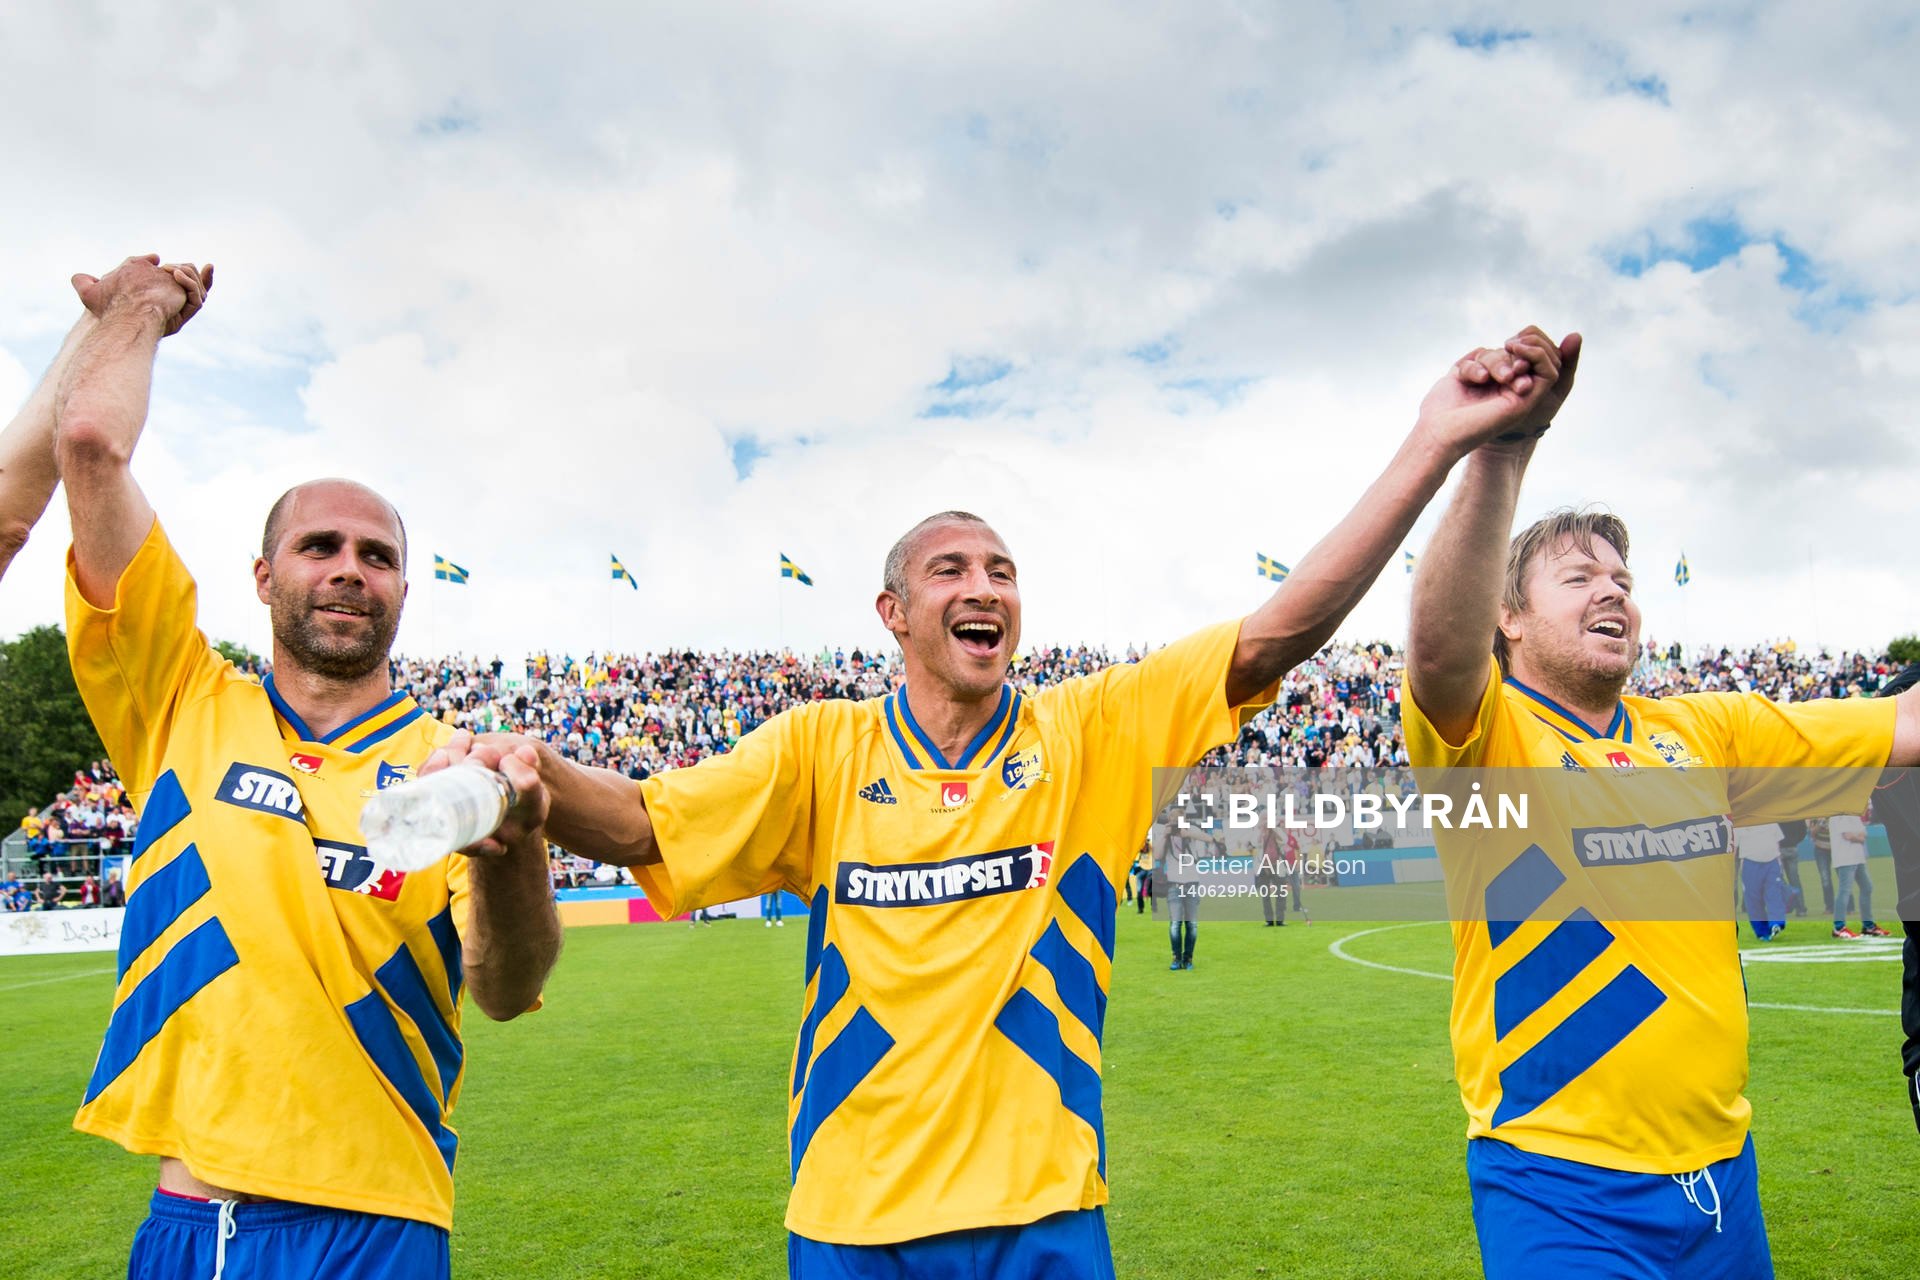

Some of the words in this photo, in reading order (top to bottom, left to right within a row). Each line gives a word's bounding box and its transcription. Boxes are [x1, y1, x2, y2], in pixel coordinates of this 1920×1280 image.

[231, 770, 306, 819] STRY
[858, 789, 898, 805] adidas
[847, 856, 1014, 902] STRYKTIPSET
